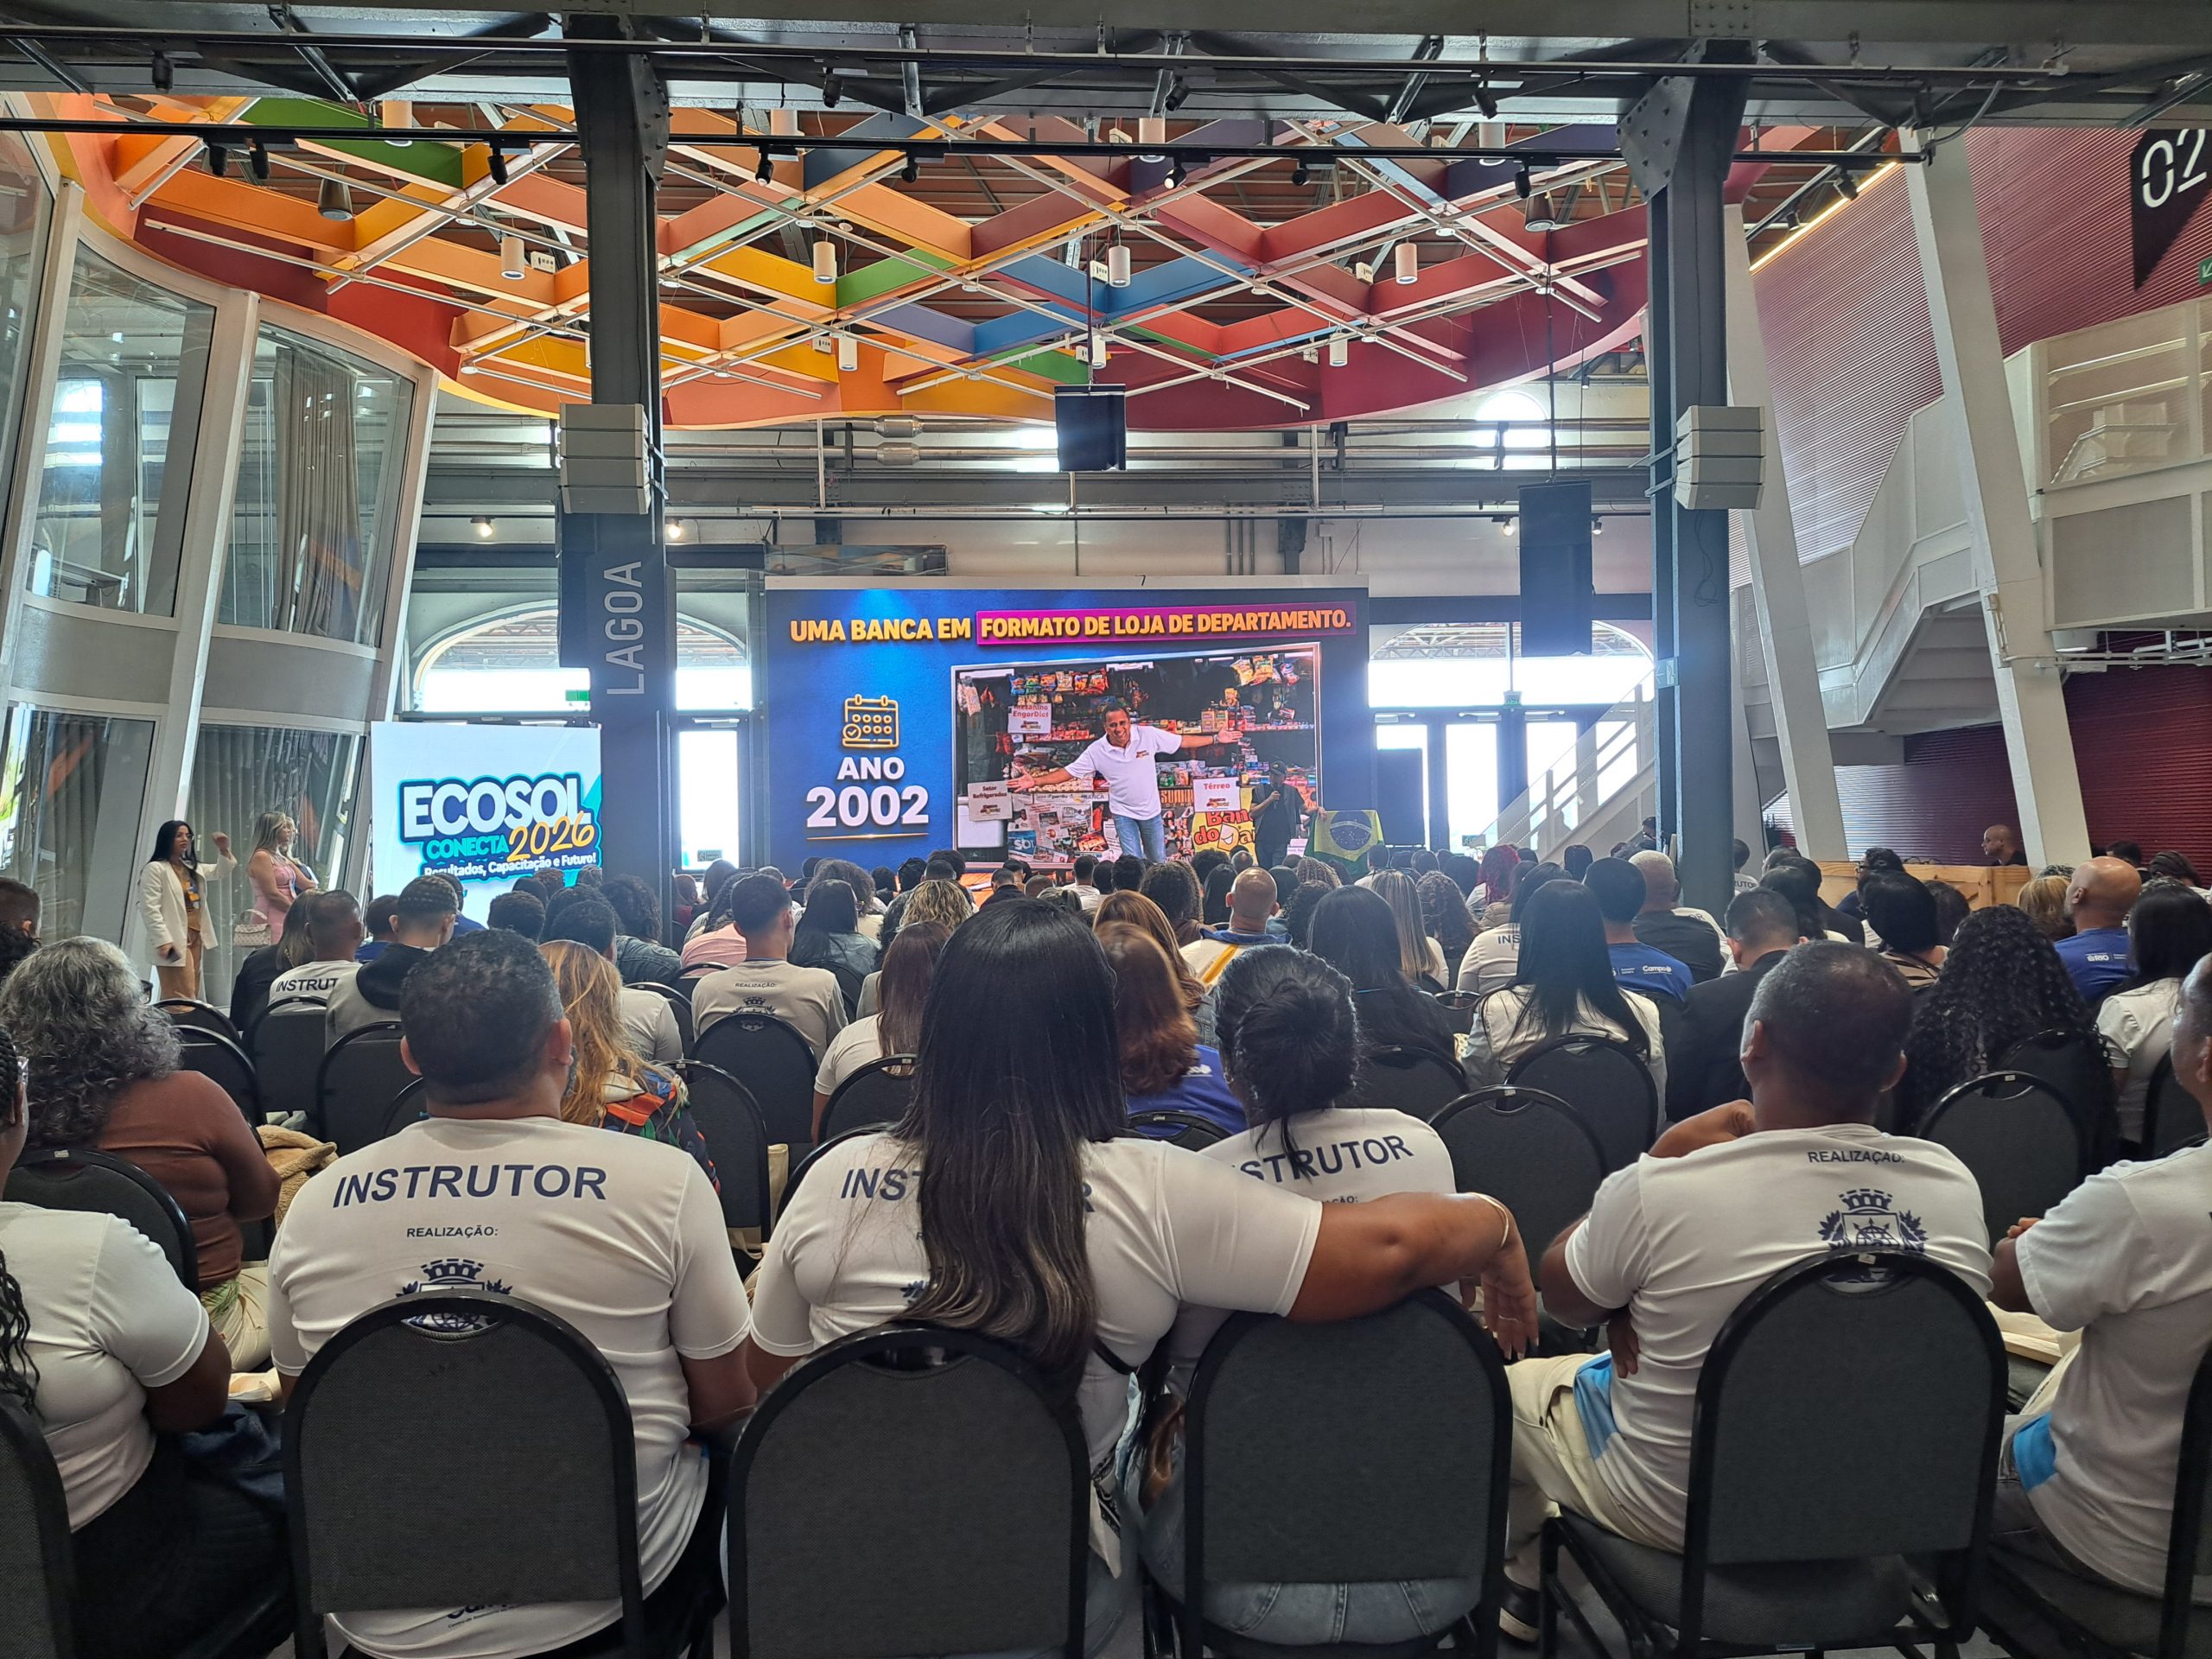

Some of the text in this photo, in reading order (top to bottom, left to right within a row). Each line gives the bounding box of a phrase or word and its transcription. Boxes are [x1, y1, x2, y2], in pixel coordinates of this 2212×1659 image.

[2141, 129, 2208, 208] 02
[603, 561, 645, 696] LAGOA
[790, 609, 1352, 642] UMA BANCA EM FORMATO DE LOJA DE DEPARTAMENTO.
[836, 756, 906, 780] ANO
[404, 778, 592, 838] ECOSOL
[805, 785, 930, 828] 2002
[426, 834, 510, 859] CONECTA
[506, 810, 595, 862] 2026
[1194, 825, 1220, 846] do
[488, 855, 551, 874] Capacitação
[553, 859, 560, 868] e
[562, 852, 597, 865] Futuro!
[1231, 1135, 1414, 1184] STRUTOR
[332, 1164, 608, 1209] INSTRUTOR
[406, 1225, 499, 1239] REALIZAÇÃO:
